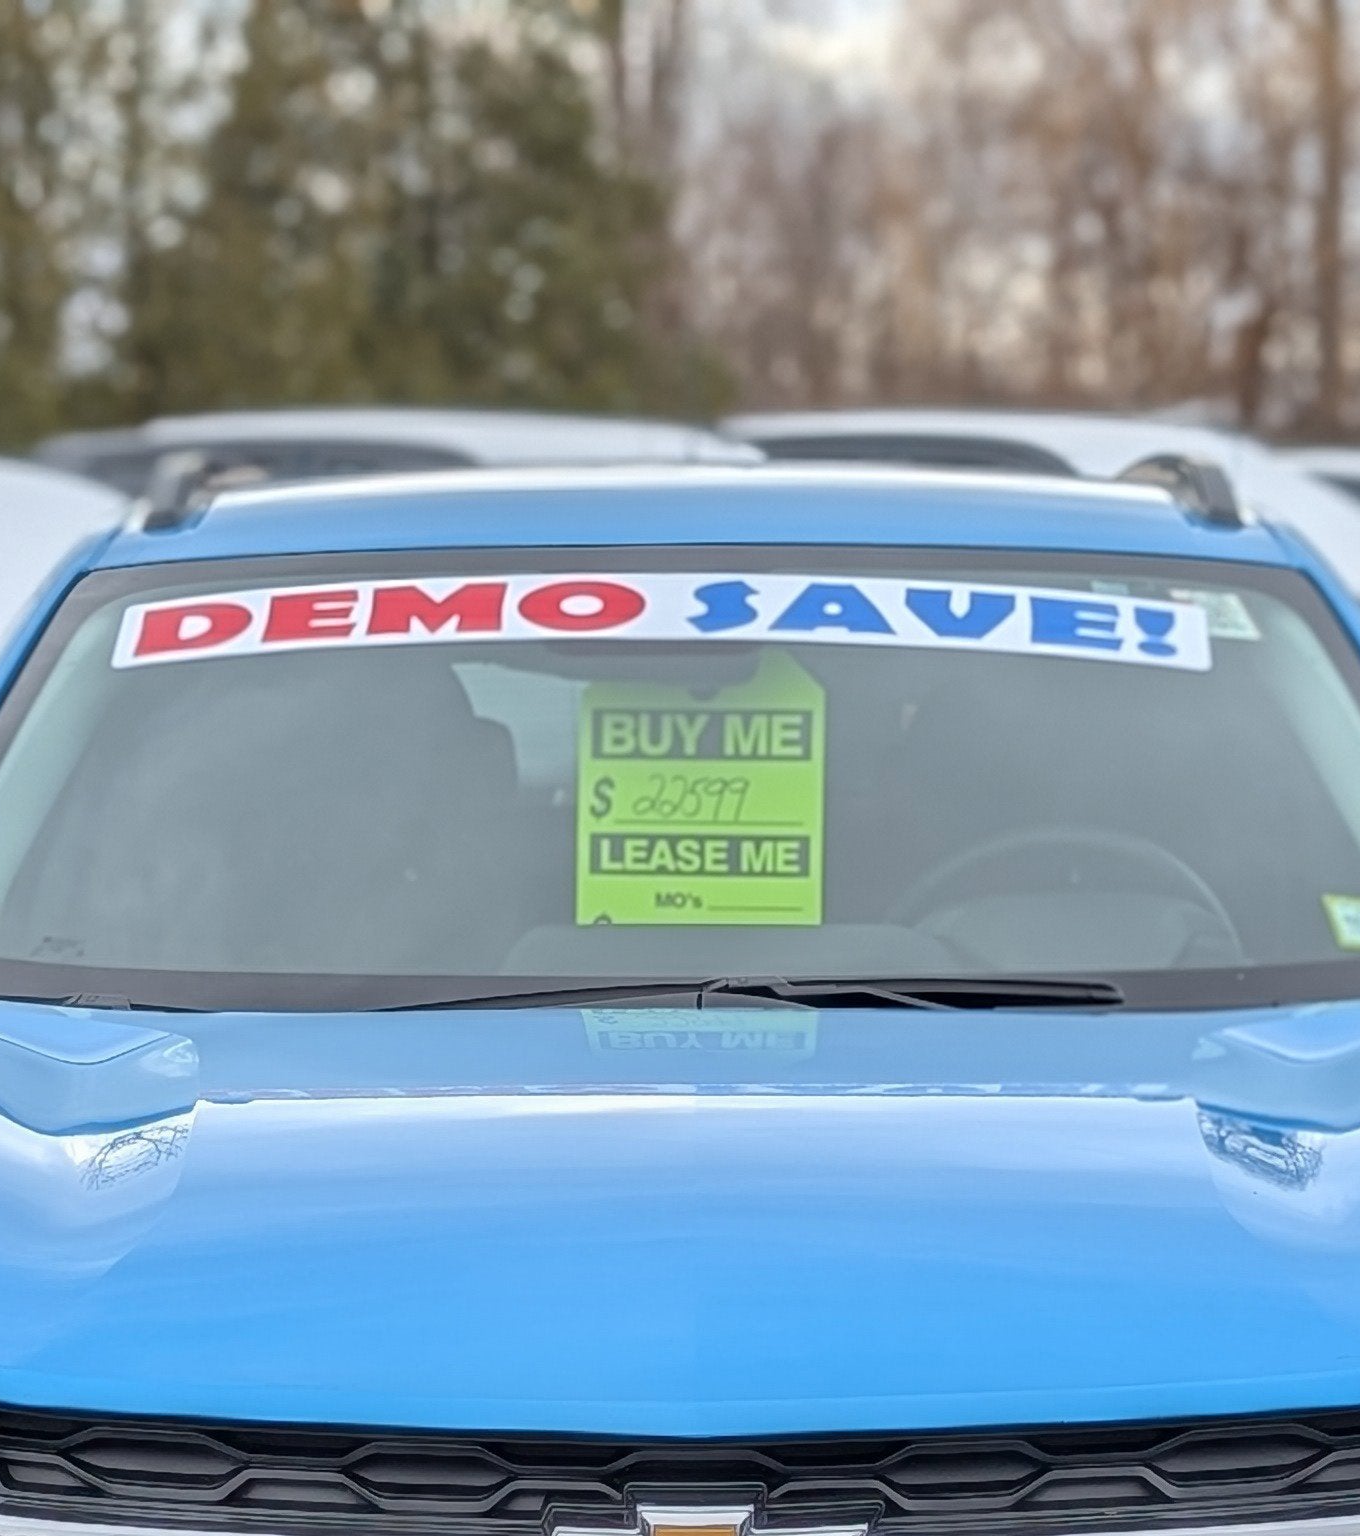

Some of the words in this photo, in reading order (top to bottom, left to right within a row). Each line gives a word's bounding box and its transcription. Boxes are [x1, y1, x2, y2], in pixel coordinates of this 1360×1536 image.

[133, 580, 647, 658] DEMO
[685, 580, 1180, 657] SAVE!
[601, 712, 710, 756] BUY
[723, 713, 803, 757] ME
[590, 775, 615, 822] $
[599, 837, 730, 873] LEASE
[740, 840, 801, 874] ME
[654, 891, 703, 910] MO's
